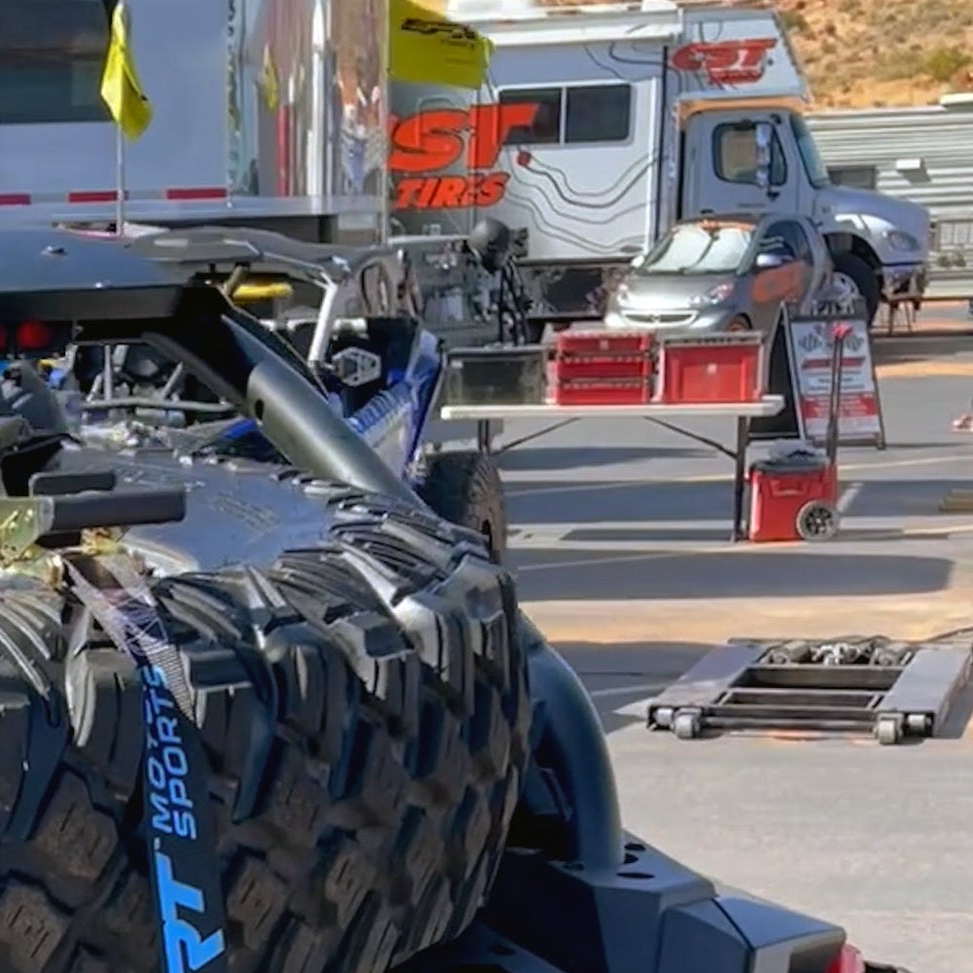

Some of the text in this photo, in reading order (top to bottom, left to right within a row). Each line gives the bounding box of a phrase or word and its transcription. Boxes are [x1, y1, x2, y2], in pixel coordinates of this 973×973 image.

[388, 103, 540, 173] ST
[395, 172, 511, 209] TIRES
[143, 664, 197, 840] SPORTS
